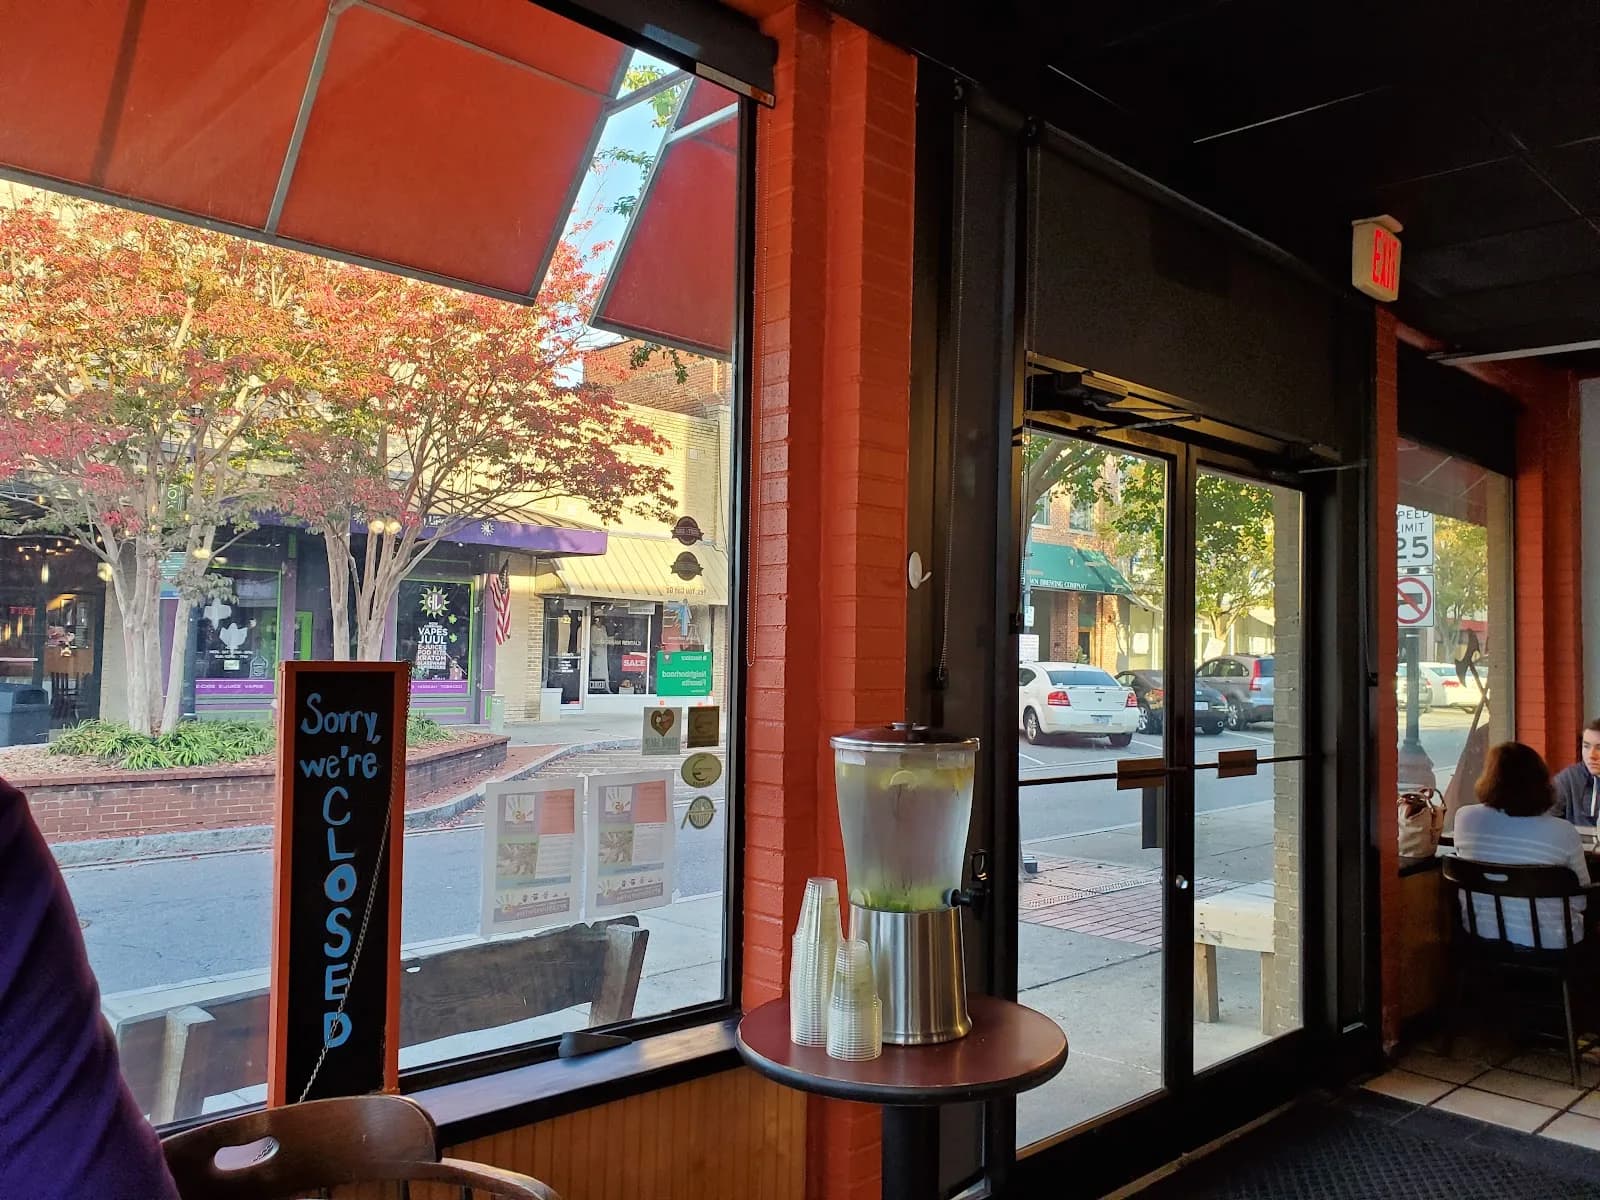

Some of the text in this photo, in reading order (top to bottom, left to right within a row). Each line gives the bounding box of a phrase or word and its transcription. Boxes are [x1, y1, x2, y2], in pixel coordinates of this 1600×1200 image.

[1372, 228, 1398, 291] EXIT
[1398, 510, 1429, 519] PEED
[1398, 522, 1424, 533] IMIT
[1398, 536, 1429, 558] 25
[1064, 581, 1088, 590] COMPANY
[418, 627, 448, 636] VAPES
[417, 635, 447, 645] JUUL
[623, 659, 646, 667] SALE
[300, 692, 382, 744] Sorry,
[300, 746, 378, 779] we're
[322, 785, 358, 1049] CLOSED
